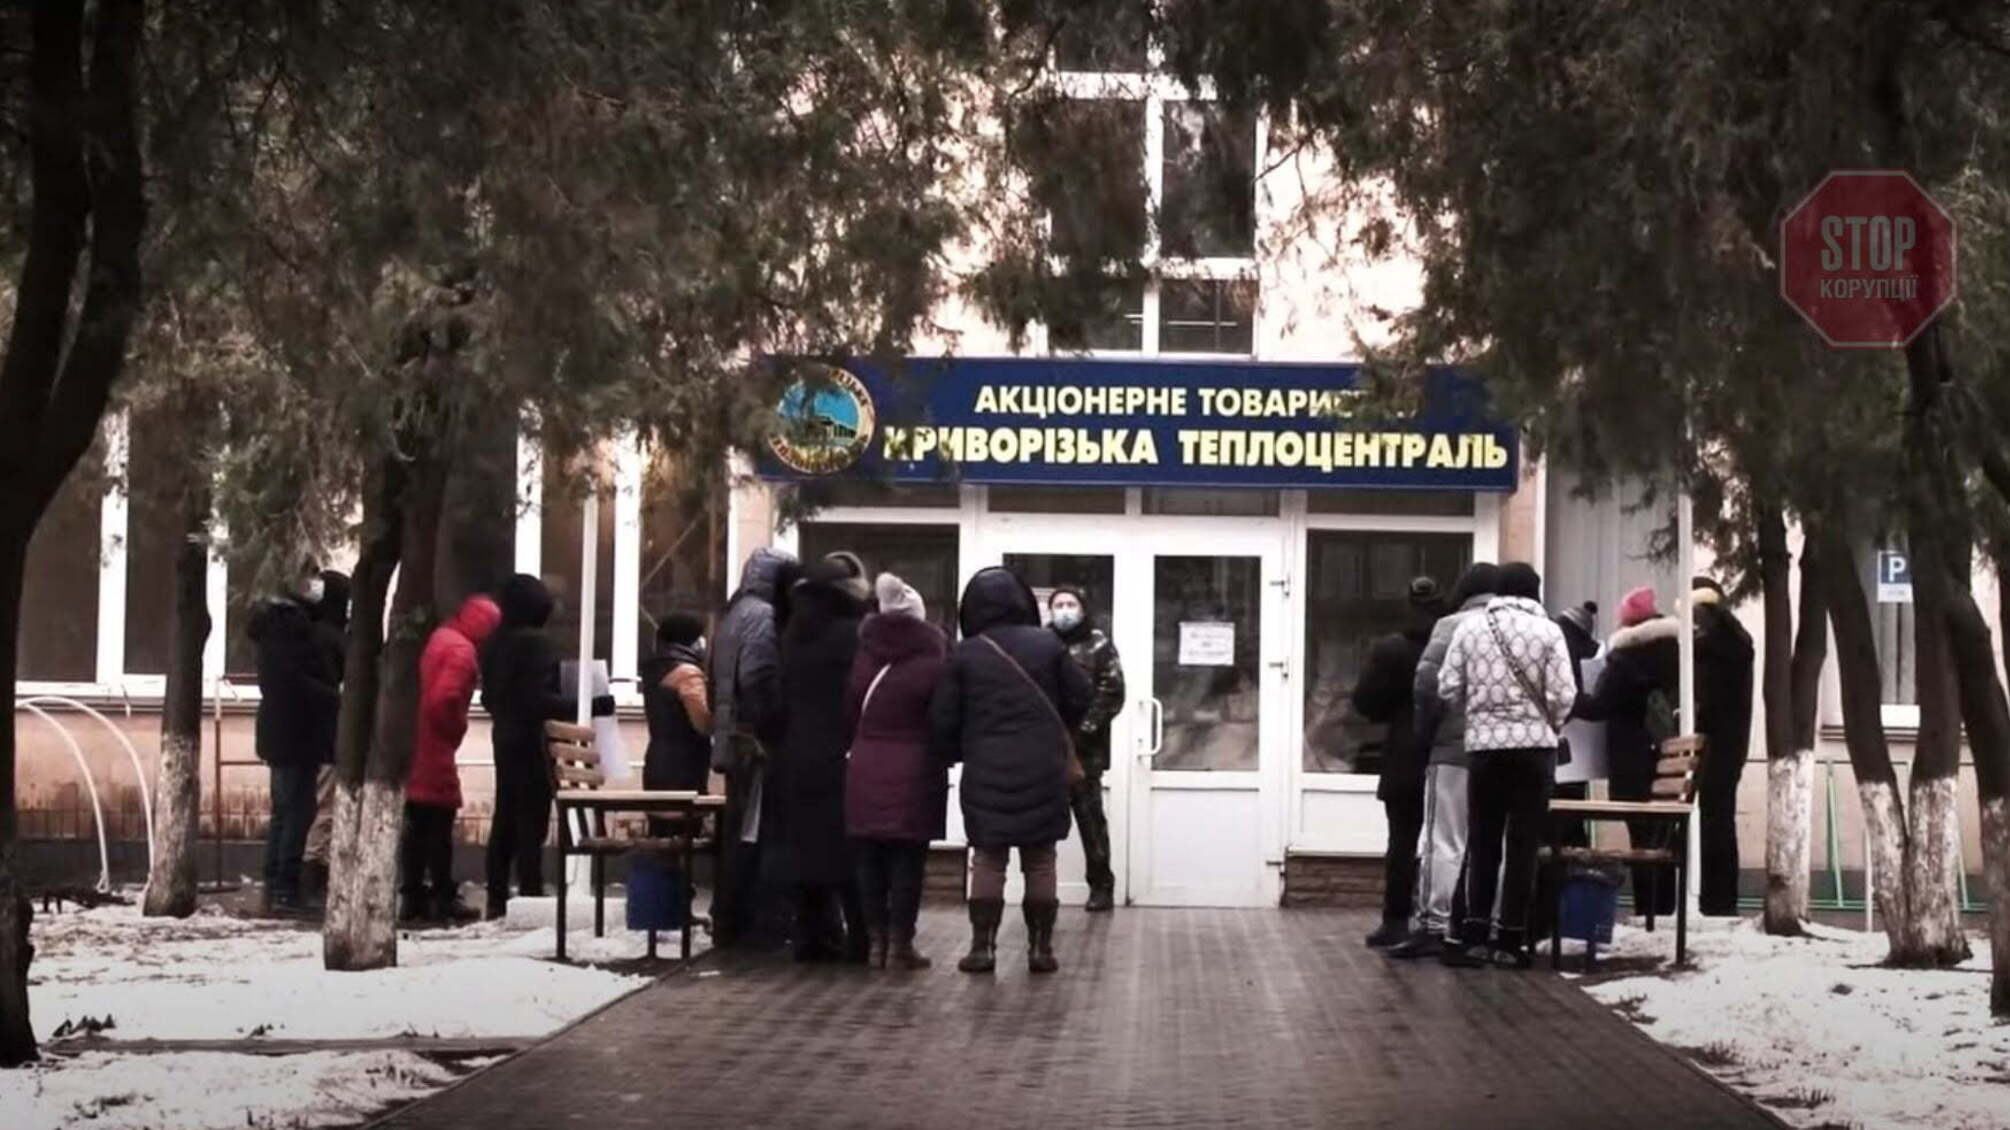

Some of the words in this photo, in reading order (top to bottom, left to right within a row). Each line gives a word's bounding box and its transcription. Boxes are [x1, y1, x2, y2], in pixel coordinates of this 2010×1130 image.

[974, 385, 1188, 419] АКЦІОНЕРНЕ
[883, 426, 1159, 464] КРИВОРІЗЬКА
[1178, 429, 1508, 473] ТЕПЛОЦЕНТРАЛЬ
[1888, 556, 1907, 582] P
